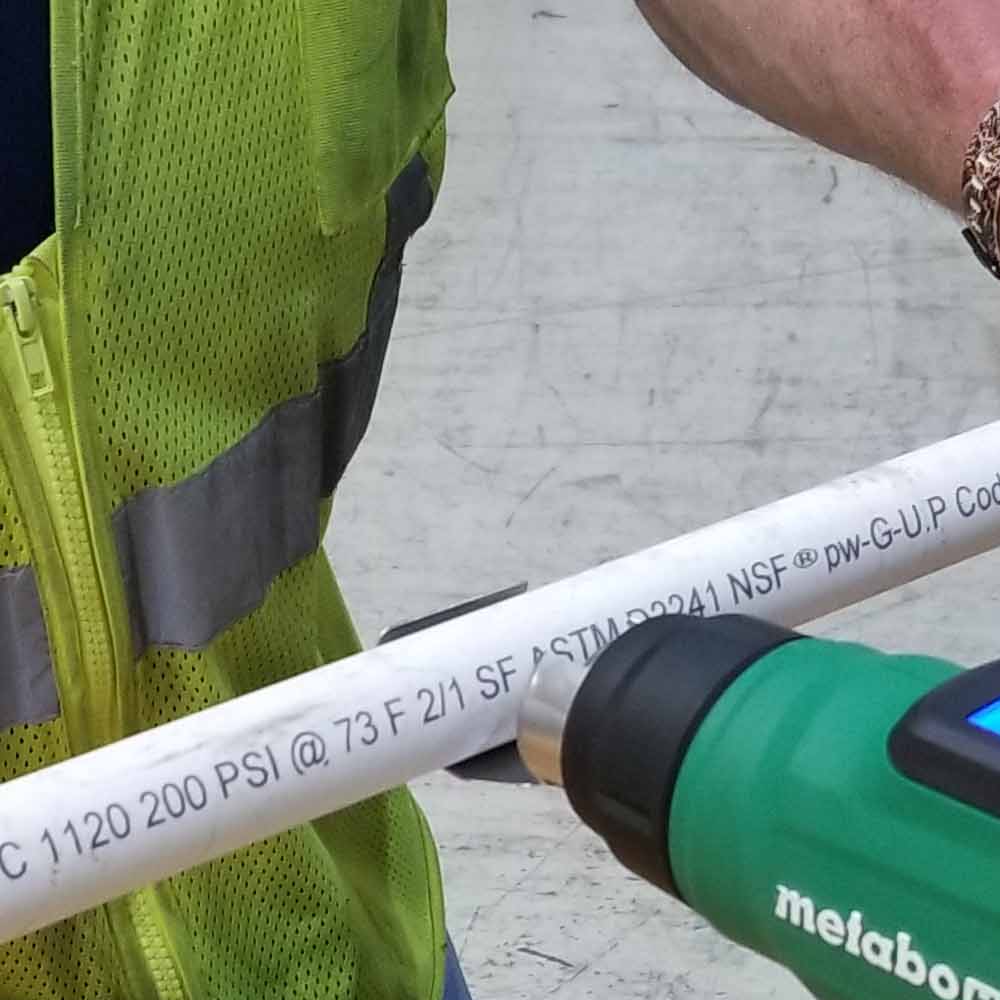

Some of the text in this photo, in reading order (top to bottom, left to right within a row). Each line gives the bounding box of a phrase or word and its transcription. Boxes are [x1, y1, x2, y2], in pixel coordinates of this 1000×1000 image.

[41, 802, 131, 865] 1120
[139, 775, 208, 829] 200
[213, 745, 280, 800] PSI
[291, 731, 329, 776] @
[333, 711, 378, 753] 73
[384, 697, 406, 736] F
[417, 676, 465, 724] 2/1
[476, 655, 517, 701] SF
[775, 884, 960, 1000] metabo
